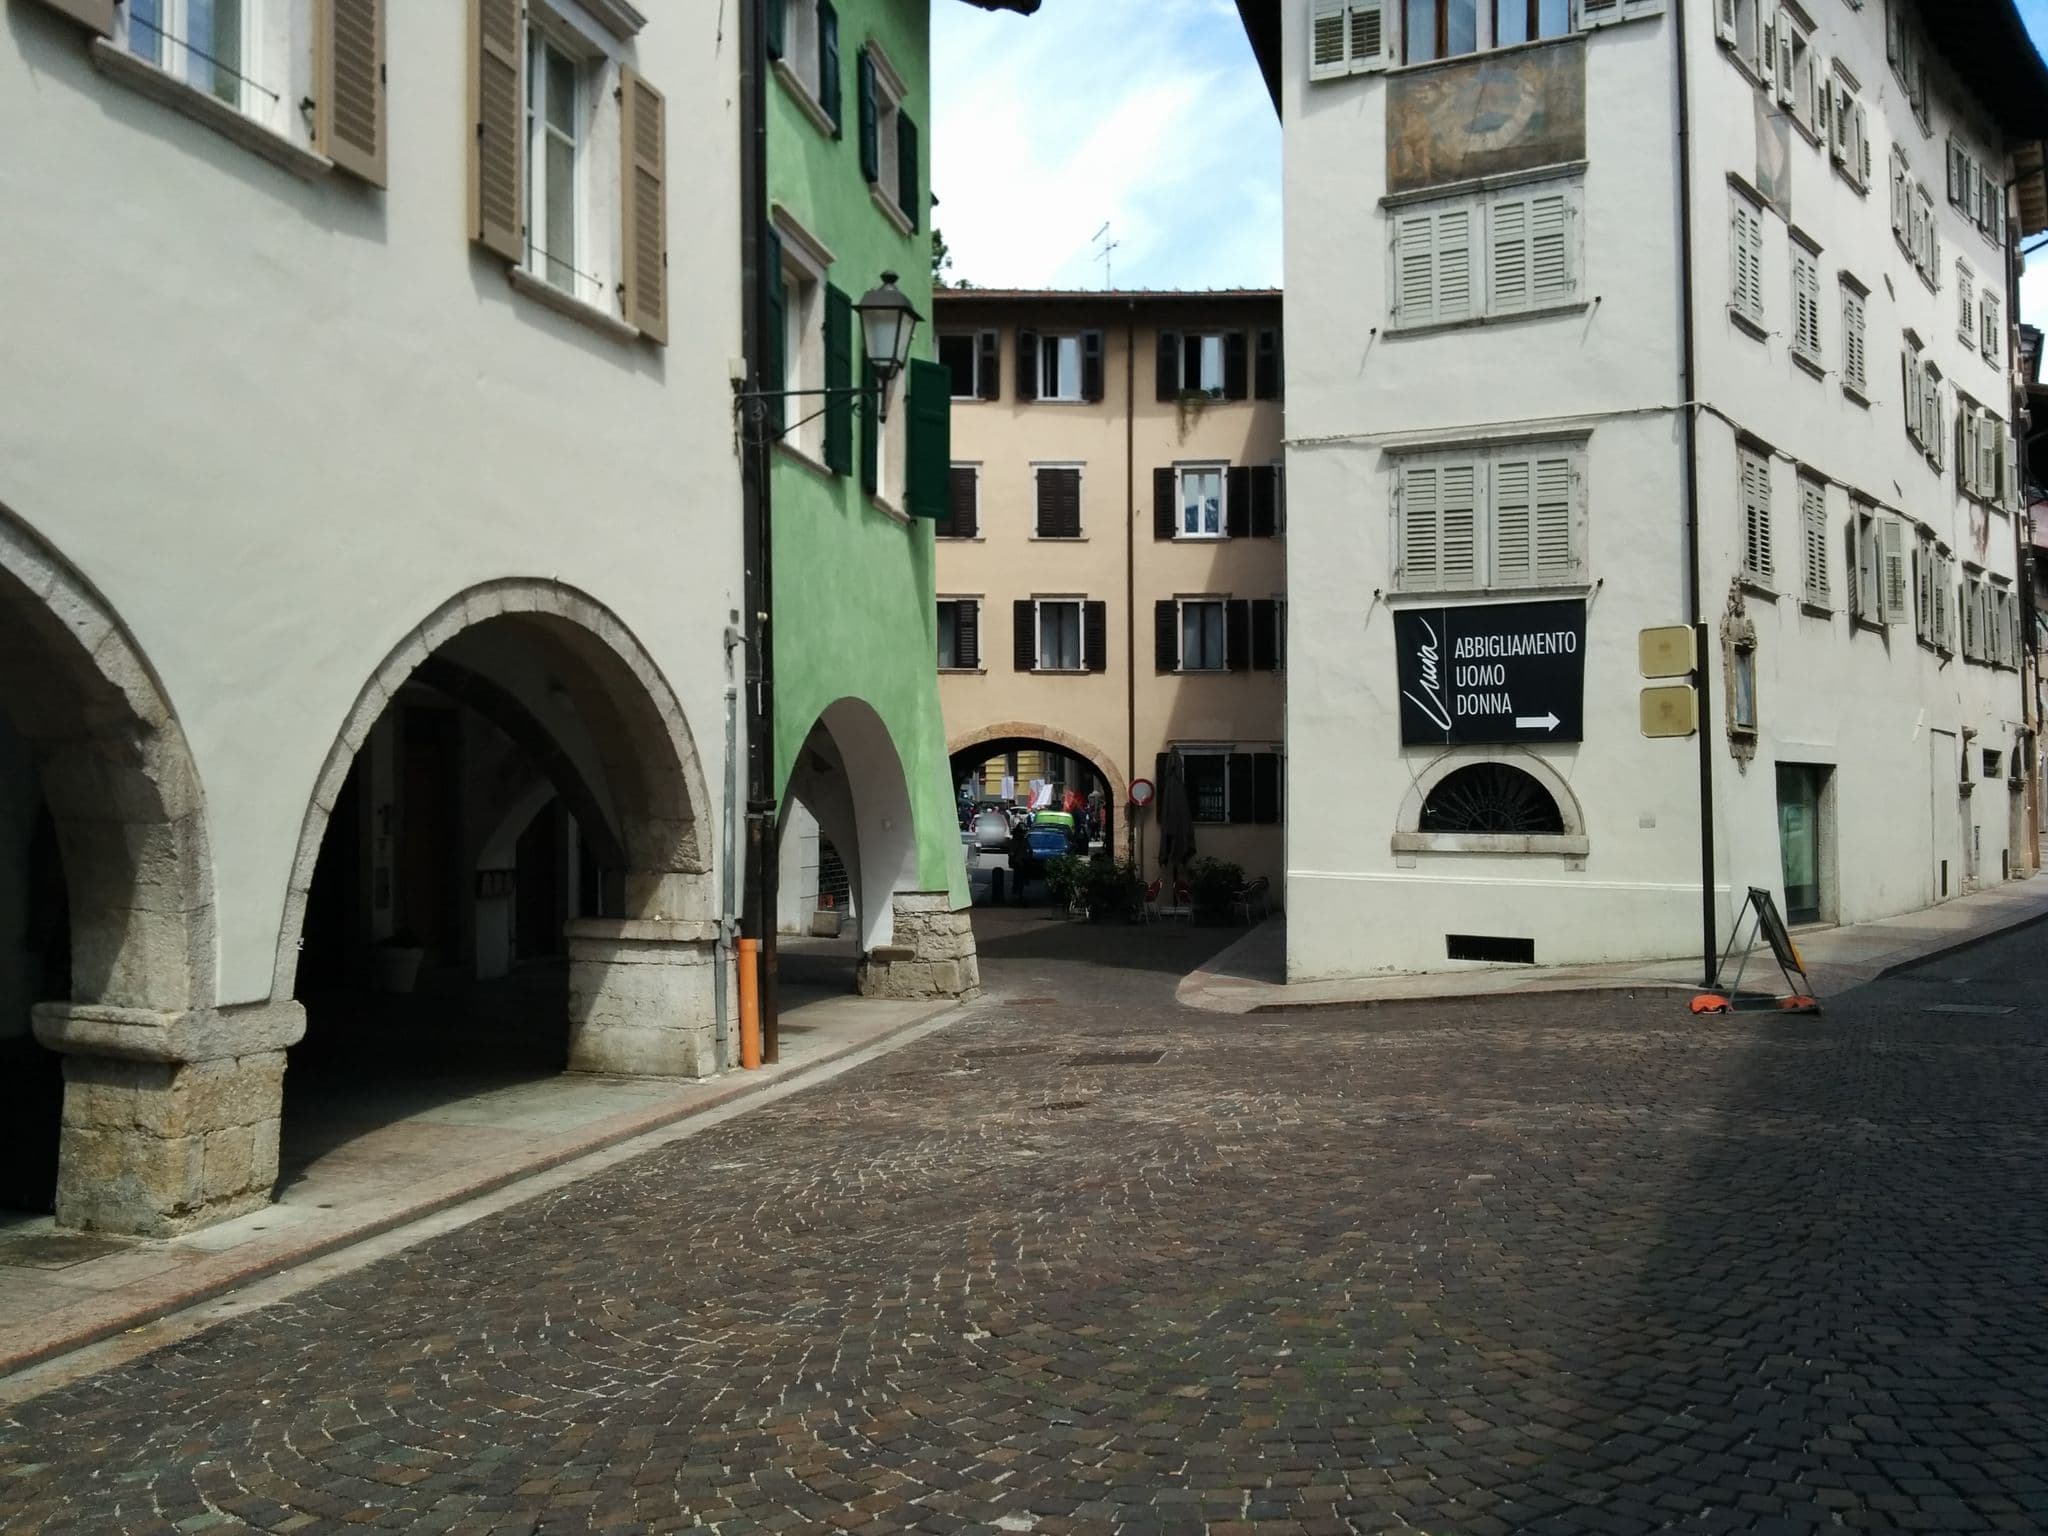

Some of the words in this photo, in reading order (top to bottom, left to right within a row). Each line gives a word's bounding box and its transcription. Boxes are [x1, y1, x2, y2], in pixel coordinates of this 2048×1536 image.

[1454, 631, 1577, 659] ABBIGLIAMENTO
[1455, 664, 1506, 687] UOMO
[1457, 692, 1513, 716] DONNA
